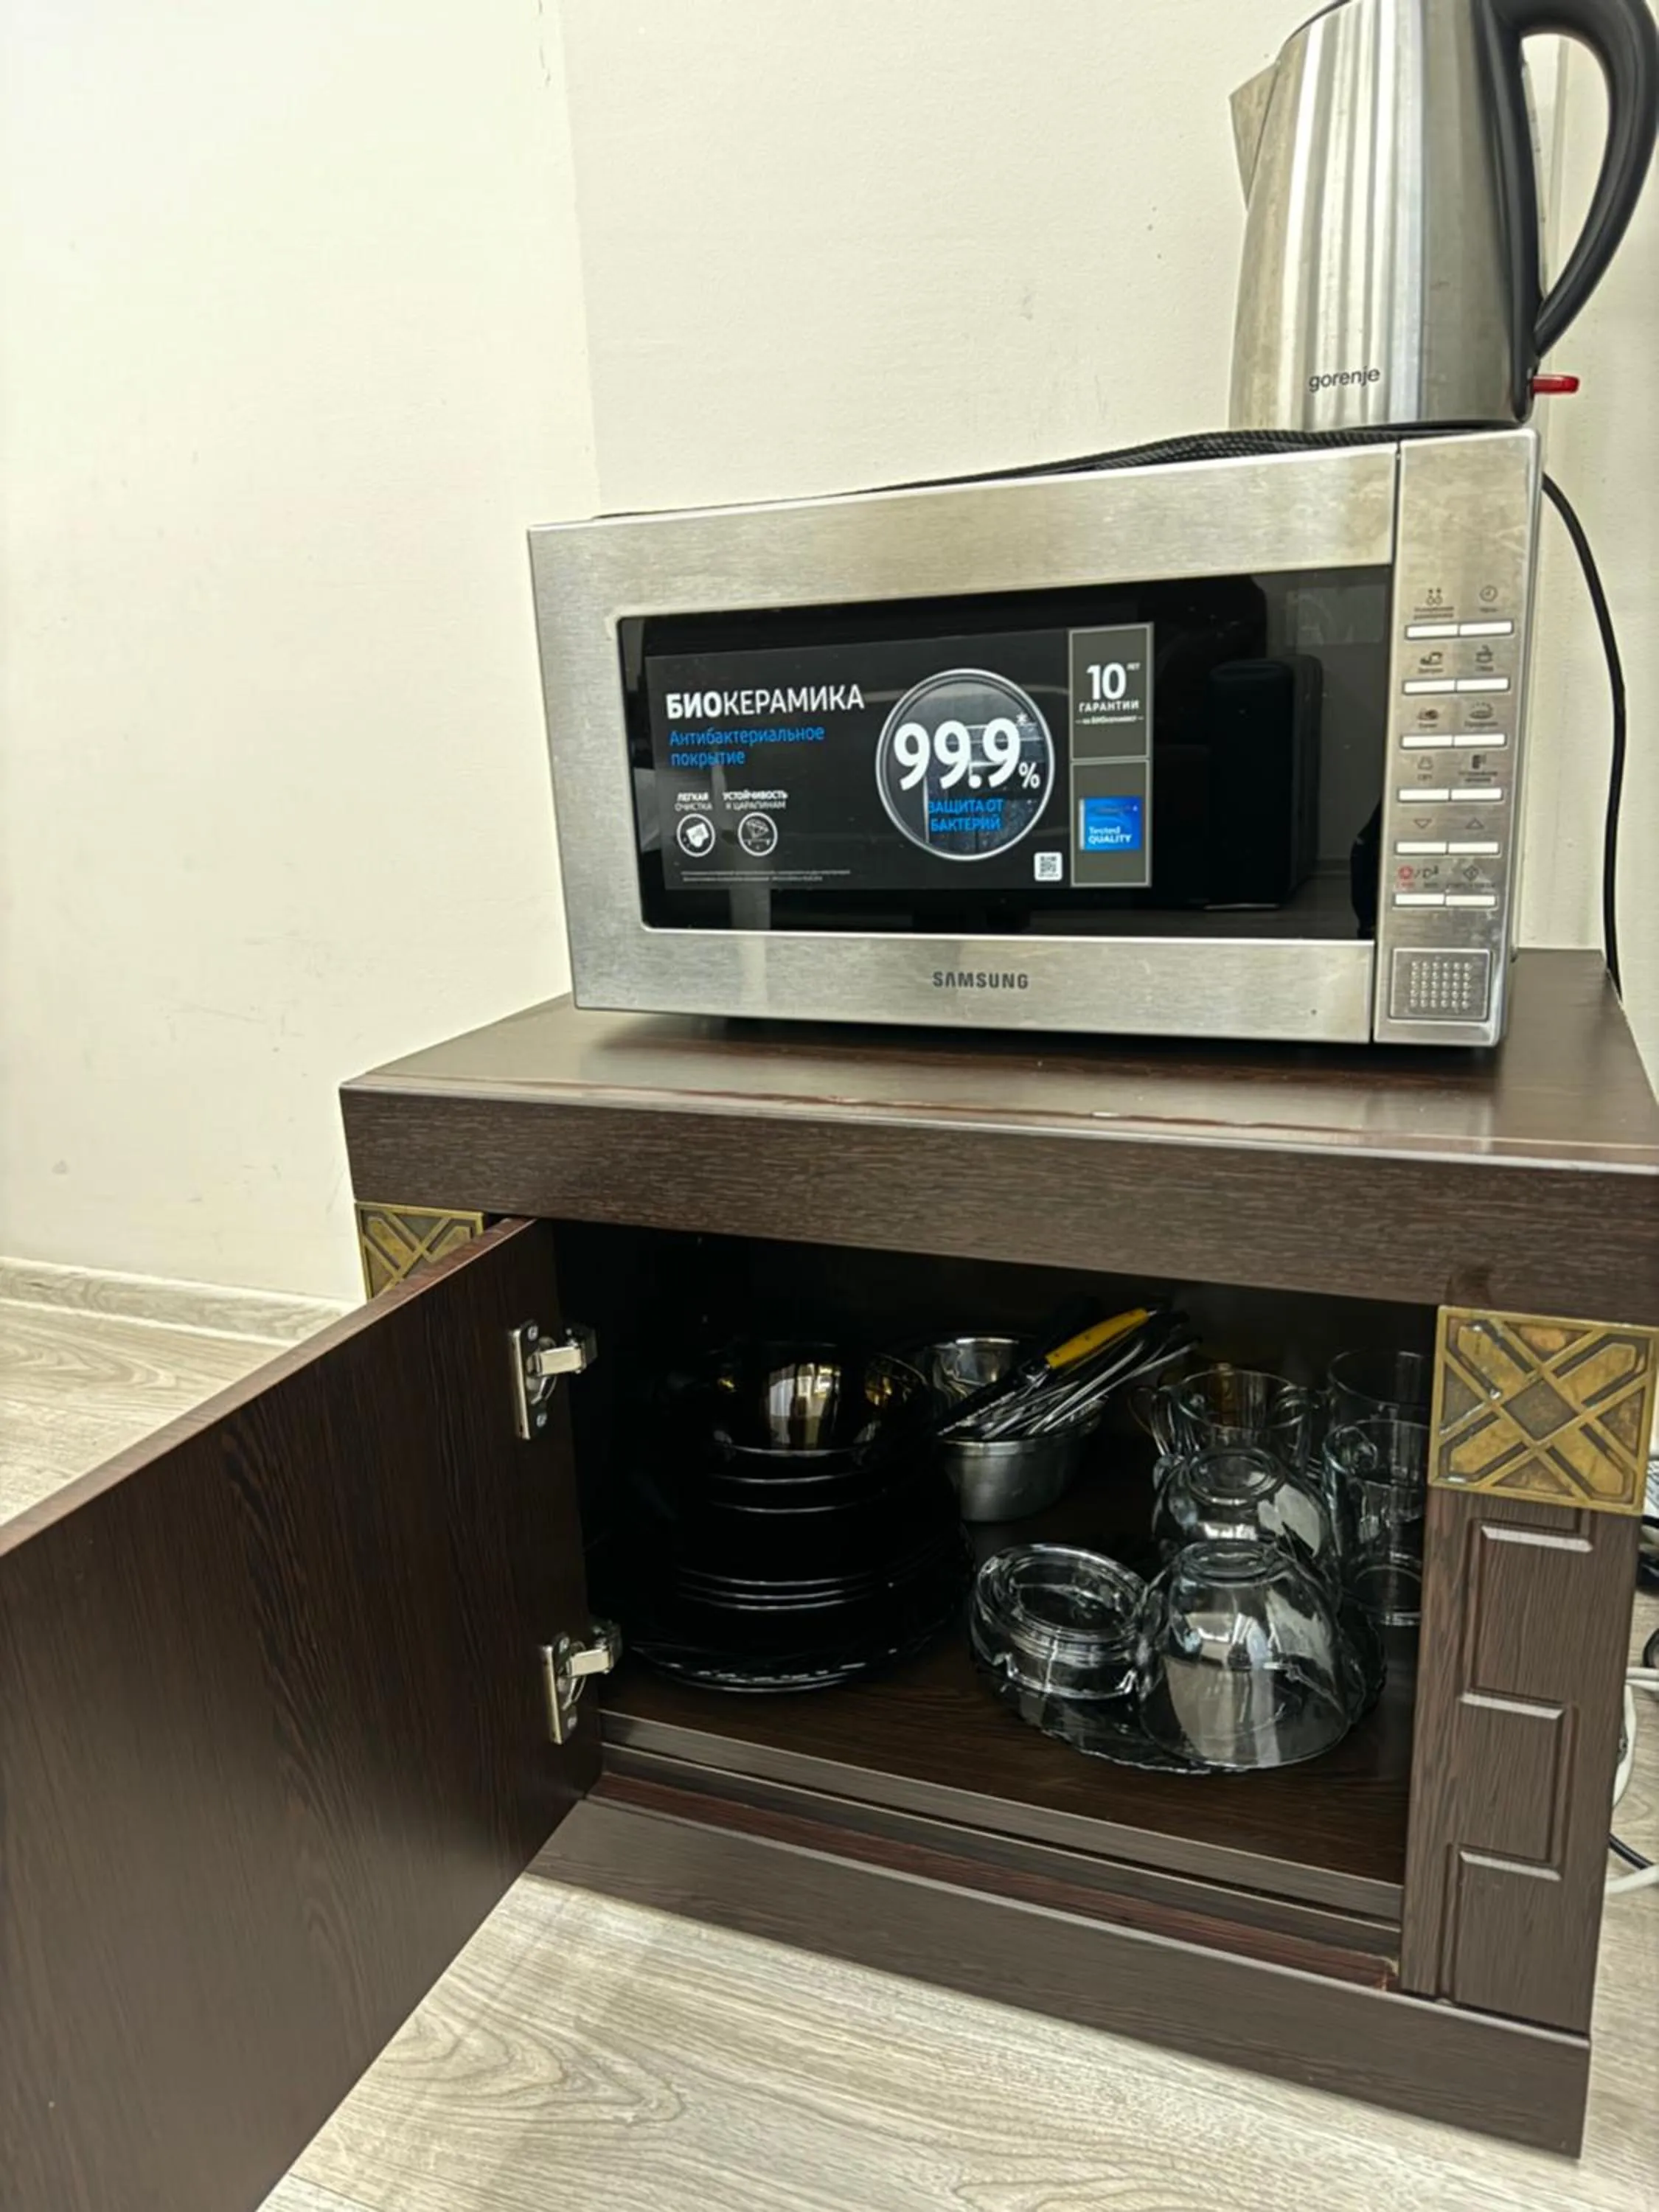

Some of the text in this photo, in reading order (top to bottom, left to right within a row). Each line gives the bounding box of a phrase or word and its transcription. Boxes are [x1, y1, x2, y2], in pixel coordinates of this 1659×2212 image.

[1309, 366, 1380, 392] gorenje
[1086, 662, 1127, 700] 10
[666, 684, 865, 719] БИОКЕРАМИКА
[1079, 700, 1139, 713] ГАРАНТИИ
[669, 726, 825, 746] Антибактериальное
[671, 751, 746, 768] покрытие
[928, 799, 1004, 815] ЗАЩИТА ОТ
[931, 814, 1001, 832] БАКТЕРИЙ
[1088, 826, 1121, 834] Tested
[1088, 834, 1132, 844] QUALITY
[933, 971, 1029, 989] SAMSUNG
